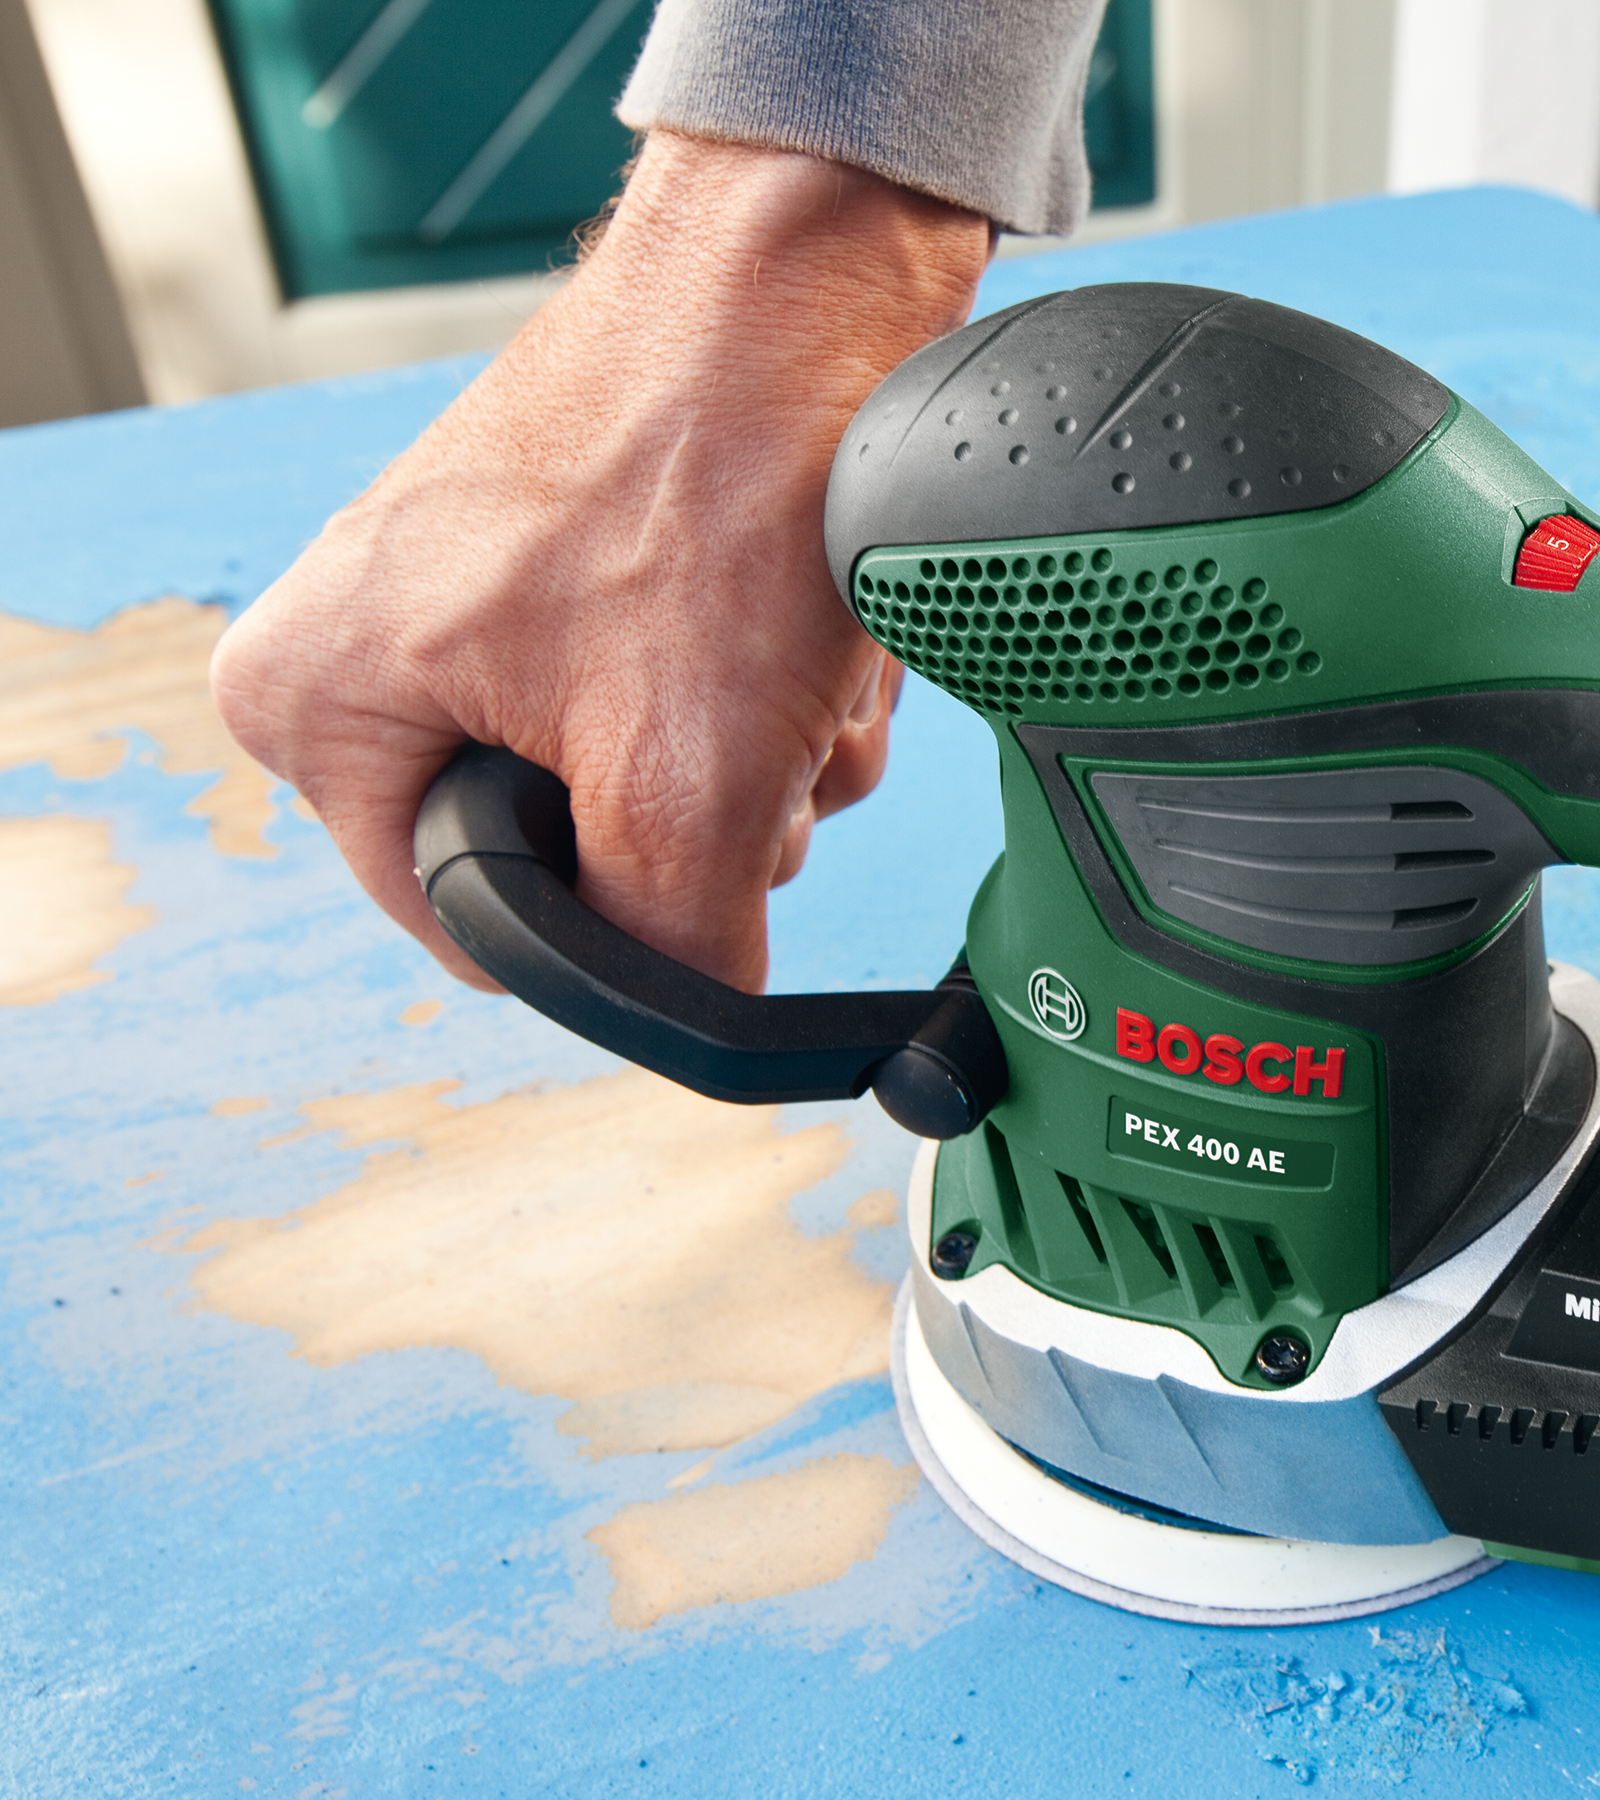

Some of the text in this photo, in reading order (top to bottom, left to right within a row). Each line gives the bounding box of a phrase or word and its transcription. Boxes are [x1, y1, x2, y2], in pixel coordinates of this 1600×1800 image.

[1547, 536, 1570, 551] 5
[1116, 1007, 1345, 1098] BOSCH
[1125, 1112, 1286, 1174] PEX 400 AE
